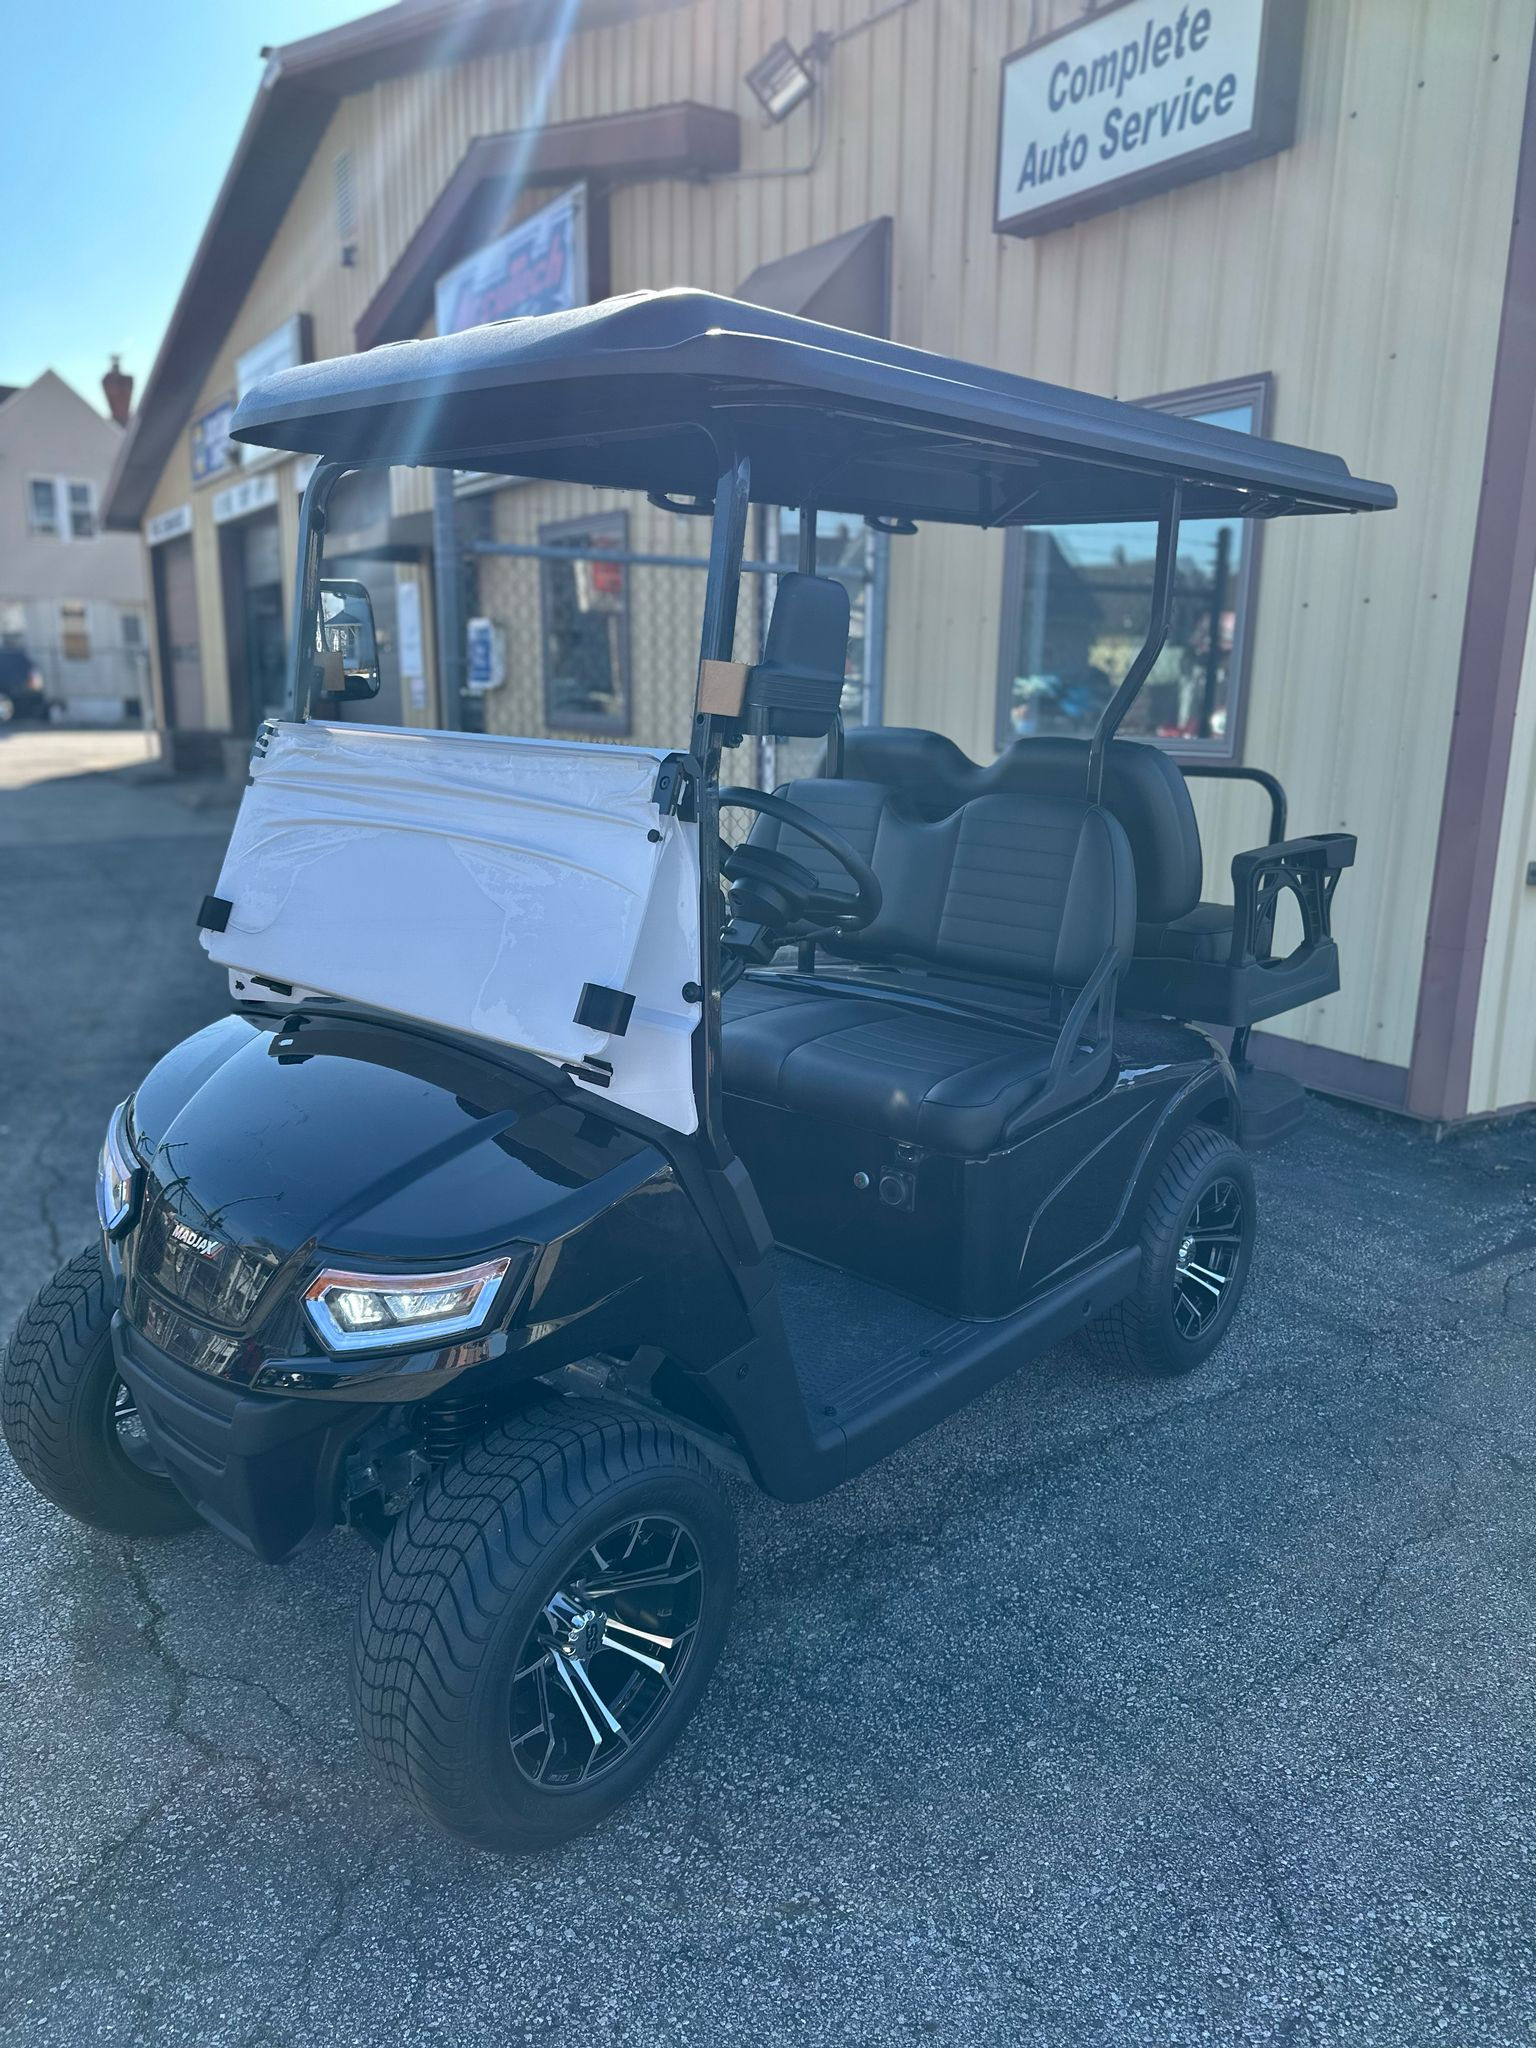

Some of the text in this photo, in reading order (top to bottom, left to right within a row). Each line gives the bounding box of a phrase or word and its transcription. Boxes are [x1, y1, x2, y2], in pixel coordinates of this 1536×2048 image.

[1049, 5, 1212, 112] Complete
[1016, 73, 1236, 193] Auto Service
[171, 1225, 219, 1256] MADJAX
